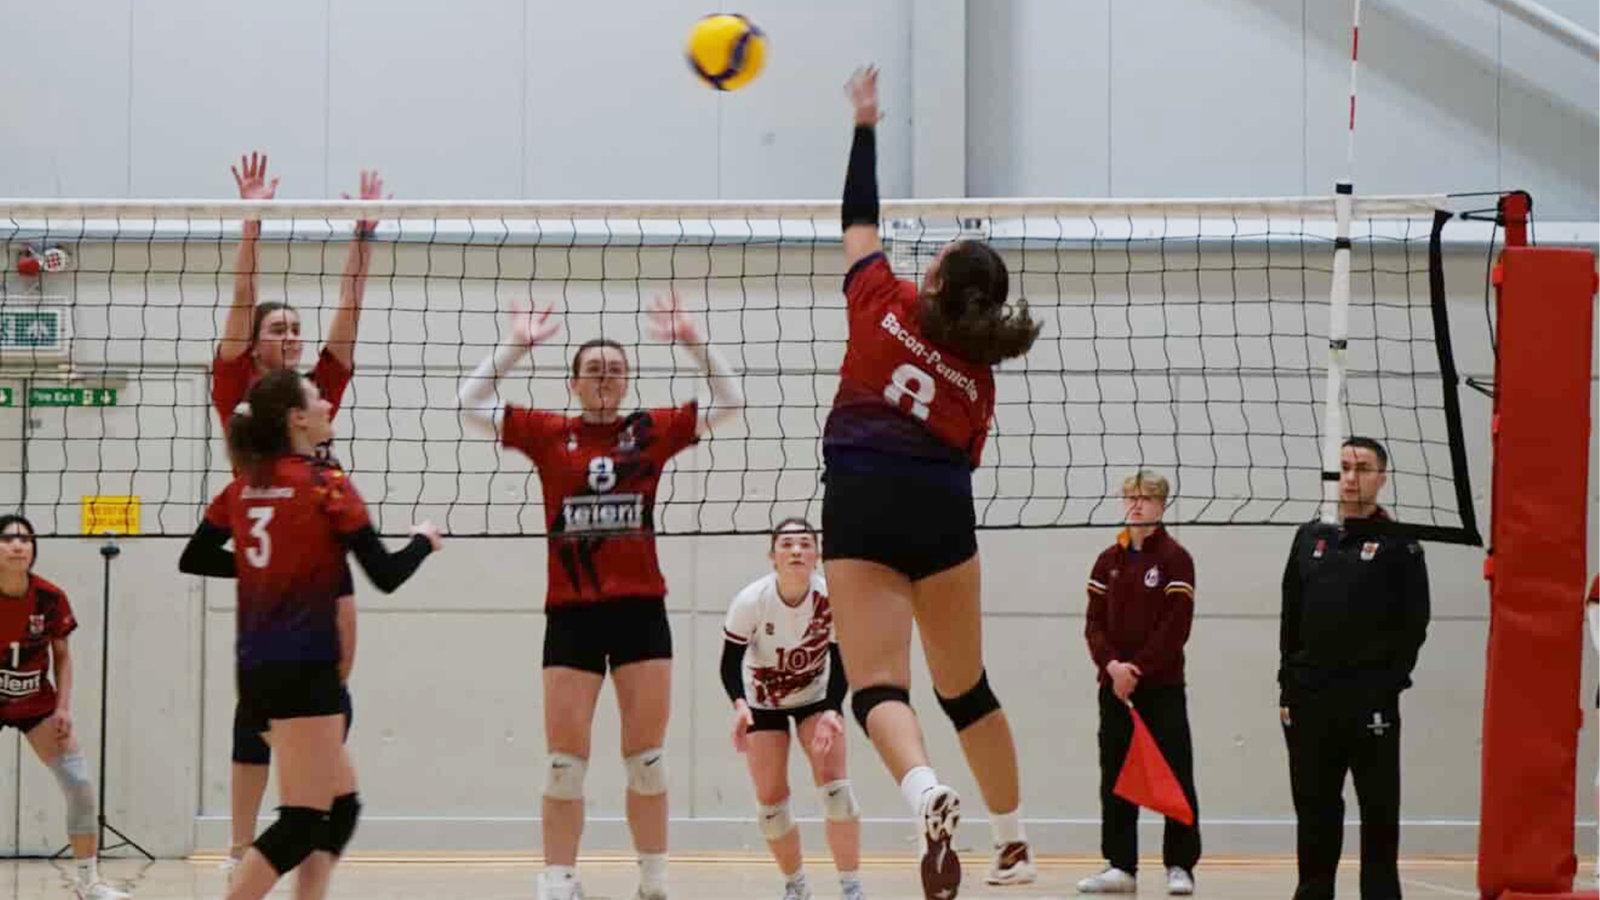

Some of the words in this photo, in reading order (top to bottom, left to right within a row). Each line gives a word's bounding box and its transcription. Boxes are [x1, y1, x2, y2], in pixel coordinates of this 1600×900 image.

[54, 391, 76, 402] Exit
[588, 456, 616, 492] 8
[246, 507, 275, 568] 3
[9, 641, 20, 669] 1
[775, 647, 809, 671] 10
